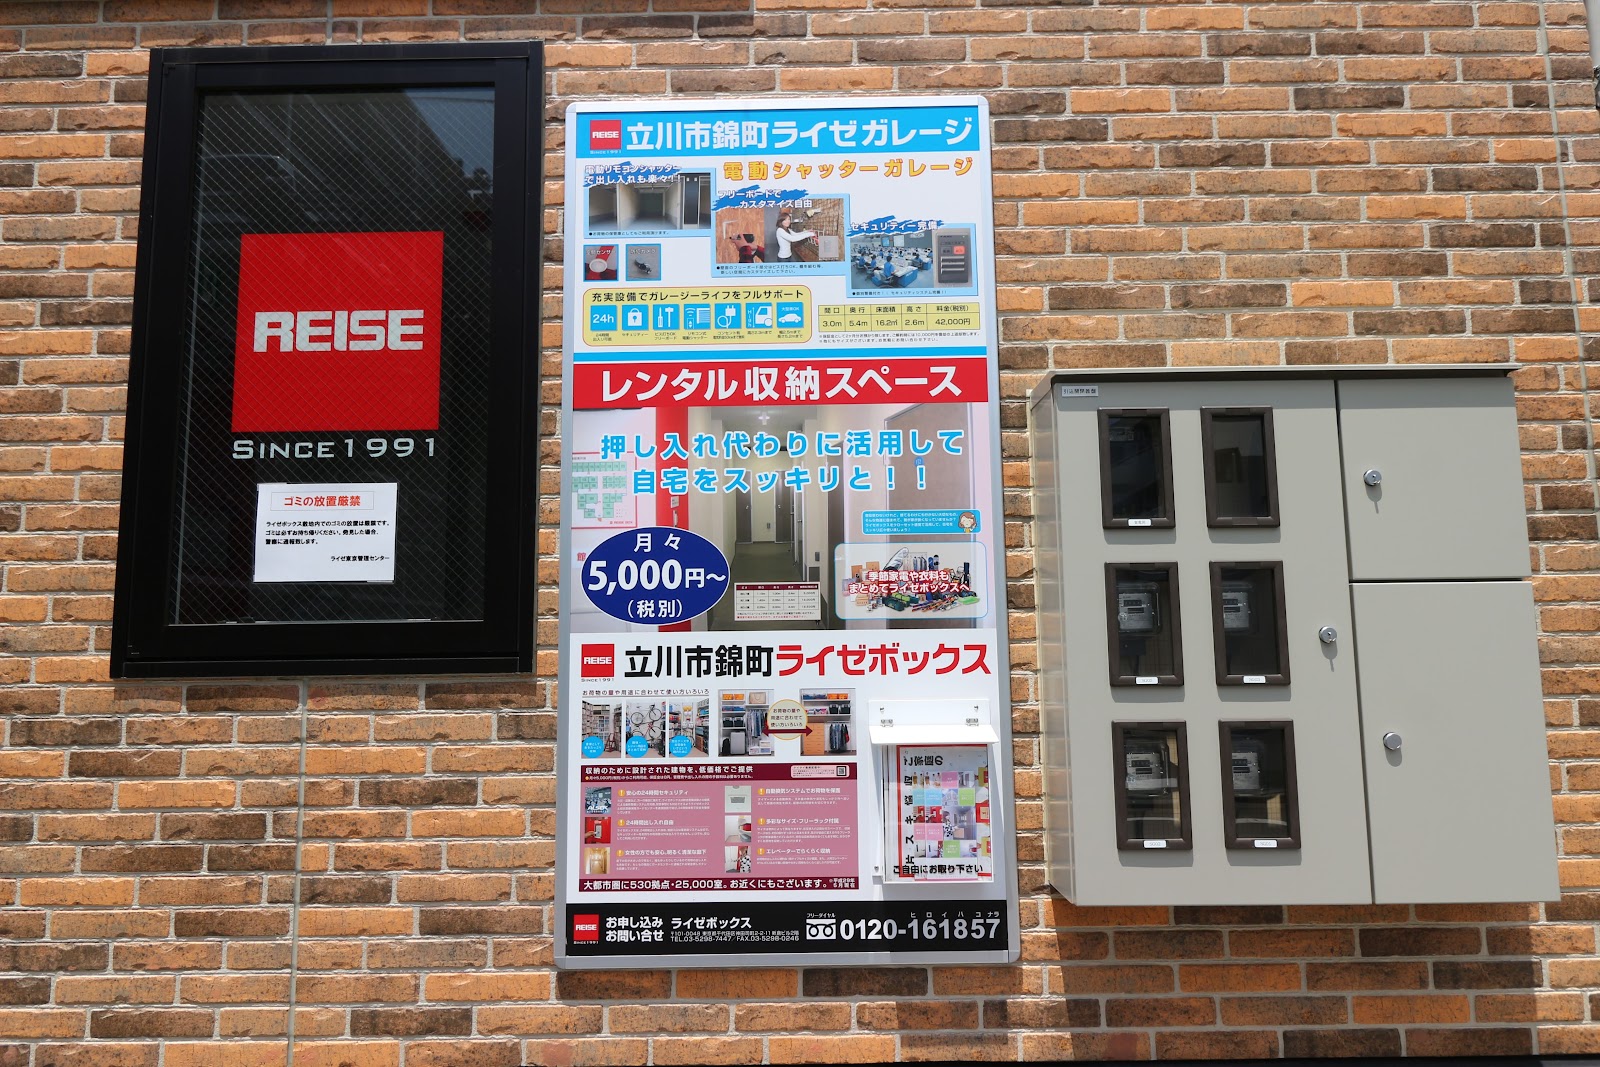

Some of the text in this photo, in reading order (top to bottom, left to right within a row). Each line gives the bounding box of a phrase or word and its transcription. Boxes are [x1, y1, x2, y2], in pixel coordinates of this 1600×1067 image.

[626, 117, 972, 151] 立川市錦町ライゼガレージ
[585, 164, 681, 174] 電動リモコンシャッター
[723, 157, 973, 180] 電動シャッターガレージ
[718, 189, 781, 198] フリーボードで
[740, 200, 812, 209] カスタマイズ自由
[851, 221, 938, 231] セキュリティー完備
[592, 290, 803, 302] 充実設備でガレージーライフをフルサポート
[593, 314, 614, 324] 24h
[254, 310, 424, 352] REISE
[602, 365, 962, 402] レンタル収納スペース
[601, 430, 964, 460] 押し入れ代わりに活用して
[633, 466, 926, 495] 自宅をスッキリと！！
[284, 496, 360, 507] ゴミの放置厳禁
[634, 533, 681, 552] 月々
[588, 559, 726, 595] 5,000円～
[868, 570, 949, 581] 季節家電や衣料も
[849, 582, 969, 594] まとめてライゼボックスへ
[627, 599, 683, 619] (税別)
[624, 643, 991, 678] 立川市錦町ライゼボックス
[904, 755, 943, 766] ご家庭の
[585, 766, 753, 774] 収納のために設計された建物を、低価格でご提供
[893, 864, 983, 874] ご自由にお取り下さい
[584, 879, 827, 890] 大都市圏に530拠点・25,000室。お近くにもございます。
[606, 917, 663, 929] お申し込み
[671, 917, 752, 929] ライゼボックス
[840, 918, 1000, 940] 0120-161857
[606, 930, 664, 942] お問い合せ
